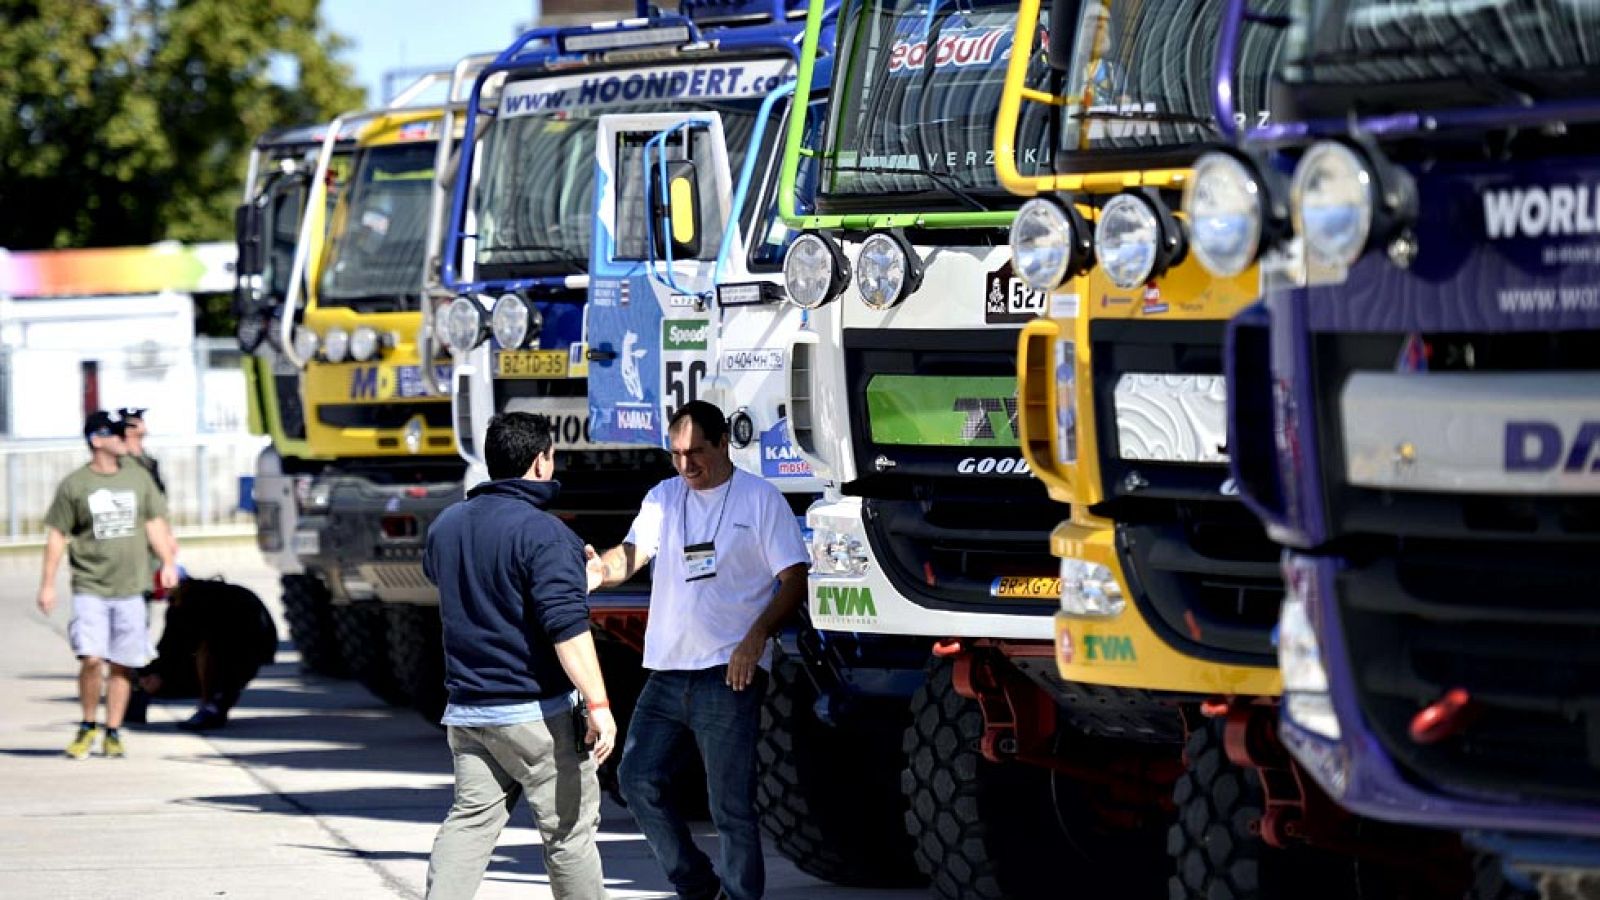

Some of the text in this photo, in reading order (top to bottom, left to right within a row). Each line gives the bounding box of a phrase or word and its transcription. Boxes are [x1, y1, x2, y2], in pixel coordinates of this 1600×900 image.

[1484, 184, 1600, 239] WORL
[1013, 282, 1046, 308] 527
[669, 324, 709, 345] Speed
[503, 355, 562, 374] BZ-TD-35
[957, 457, 1032, 474] GOOD
[816, 586, 878, 617] TVM
[1083, 635, 1137, 662] TVM
